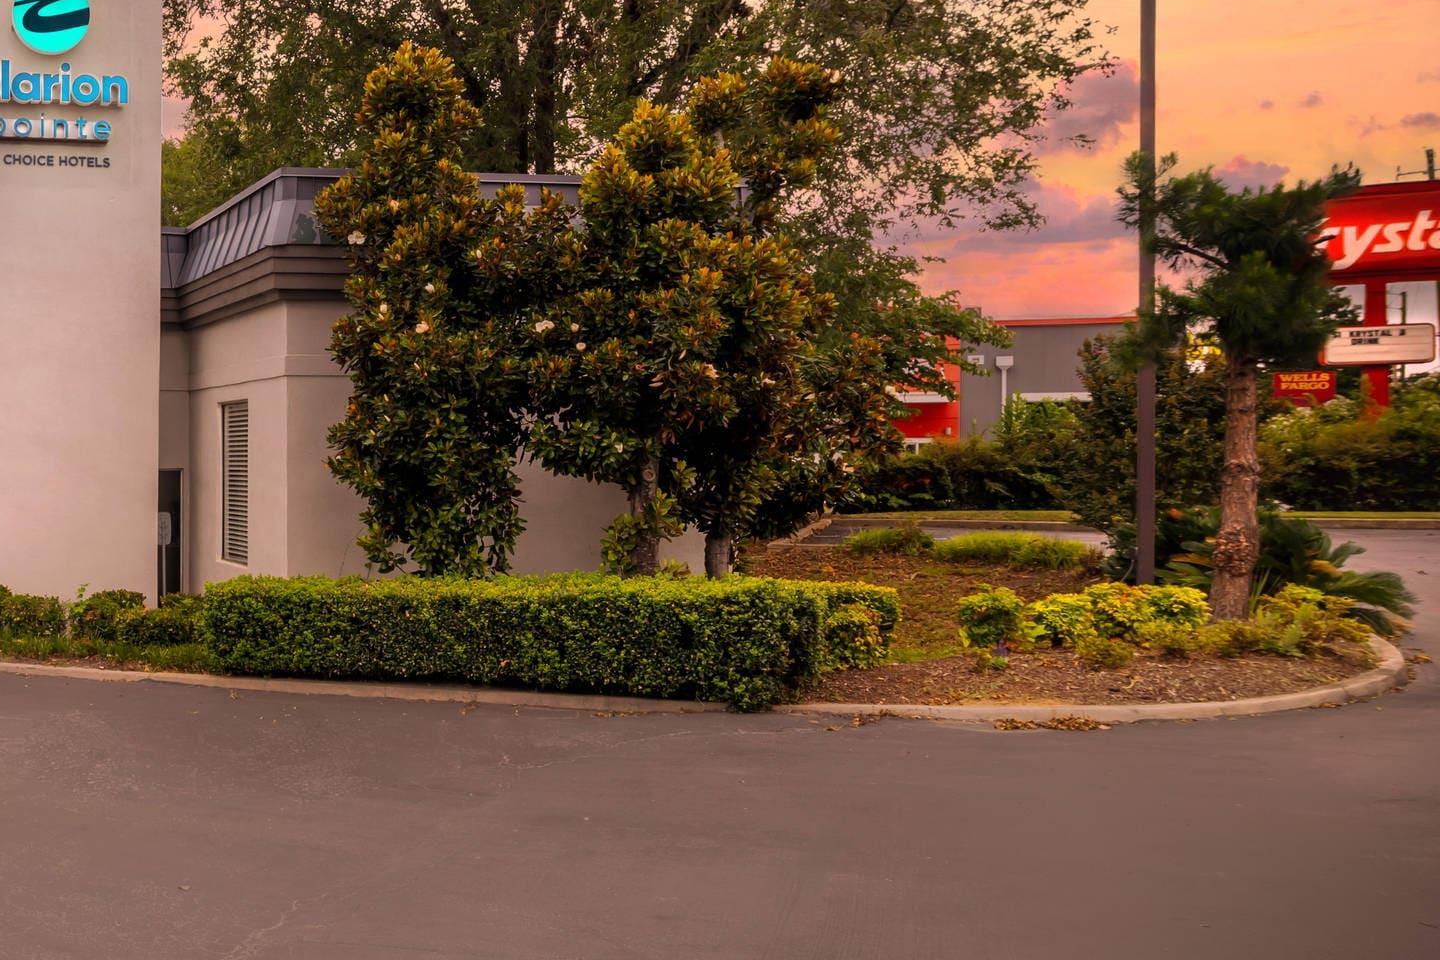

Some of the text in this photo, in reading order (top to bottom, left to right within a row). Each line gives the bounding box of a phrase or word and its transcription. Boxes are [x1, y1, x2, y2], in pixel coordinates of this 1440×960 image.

[3, 154, 55, 167] CHOICE
[59, 155, 111, 169] HOTELS
[1314, 209, 1440, 271] ryst
[1349, 329, 1392, 338] KRYSTAL
[1278, 373, 1330, 382] WELLS
[1280, 381, 1330, 390] FARGO
